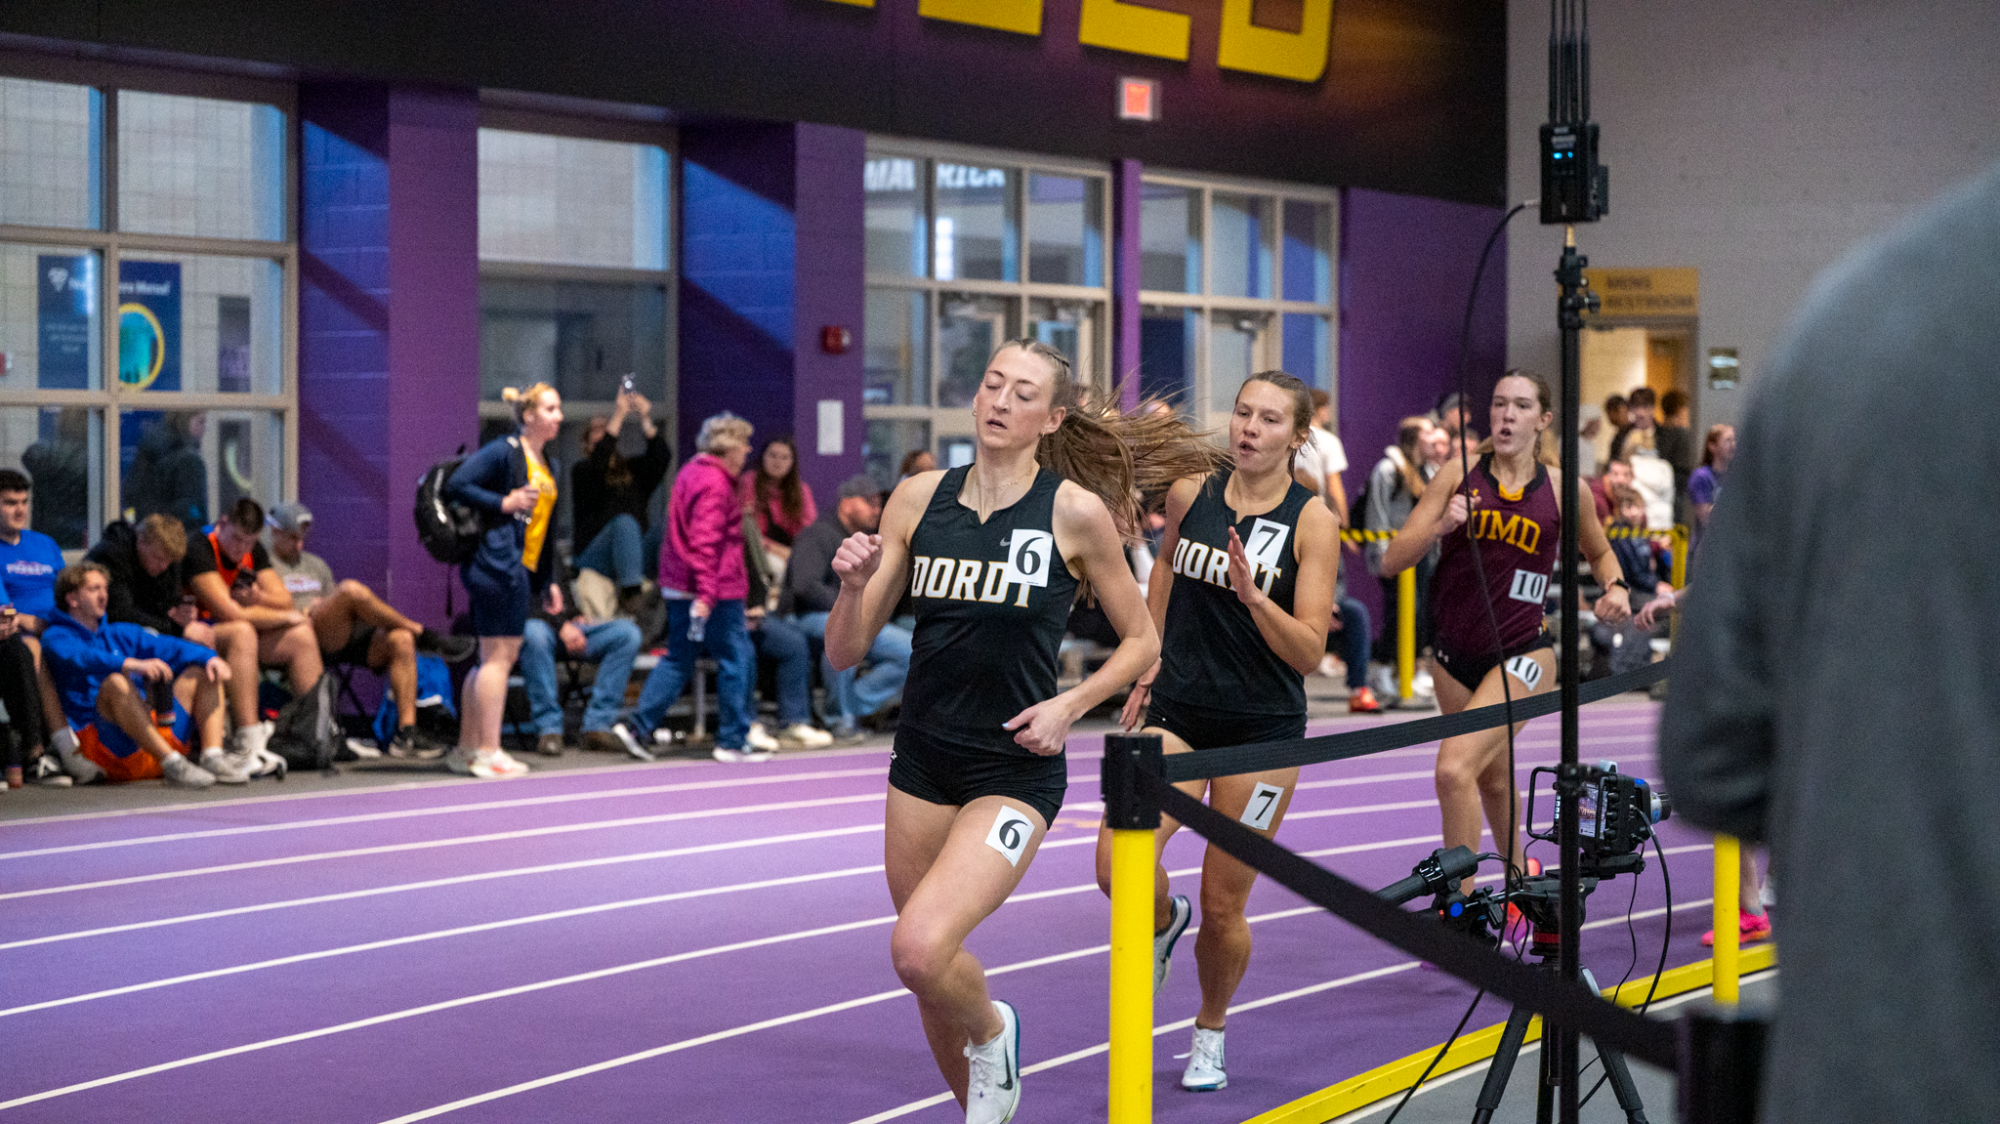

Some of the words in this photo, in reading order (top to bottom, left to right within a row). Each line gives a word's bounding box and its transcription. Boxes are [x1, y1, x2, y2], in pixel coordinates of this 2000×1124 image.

[1257, 525, 1281, 556] 7
[1467, 509, 1541, 555] UMD
[1016, 537, 1044, 576] 6
[1172, 537, 1282, 598] DORT
[1515, 573, 1544, 600] 10
[1511, 656, 1540, 683] 10
[1254, 789, 1278, 821] 7
[998, 818, 1028, 850] 6
